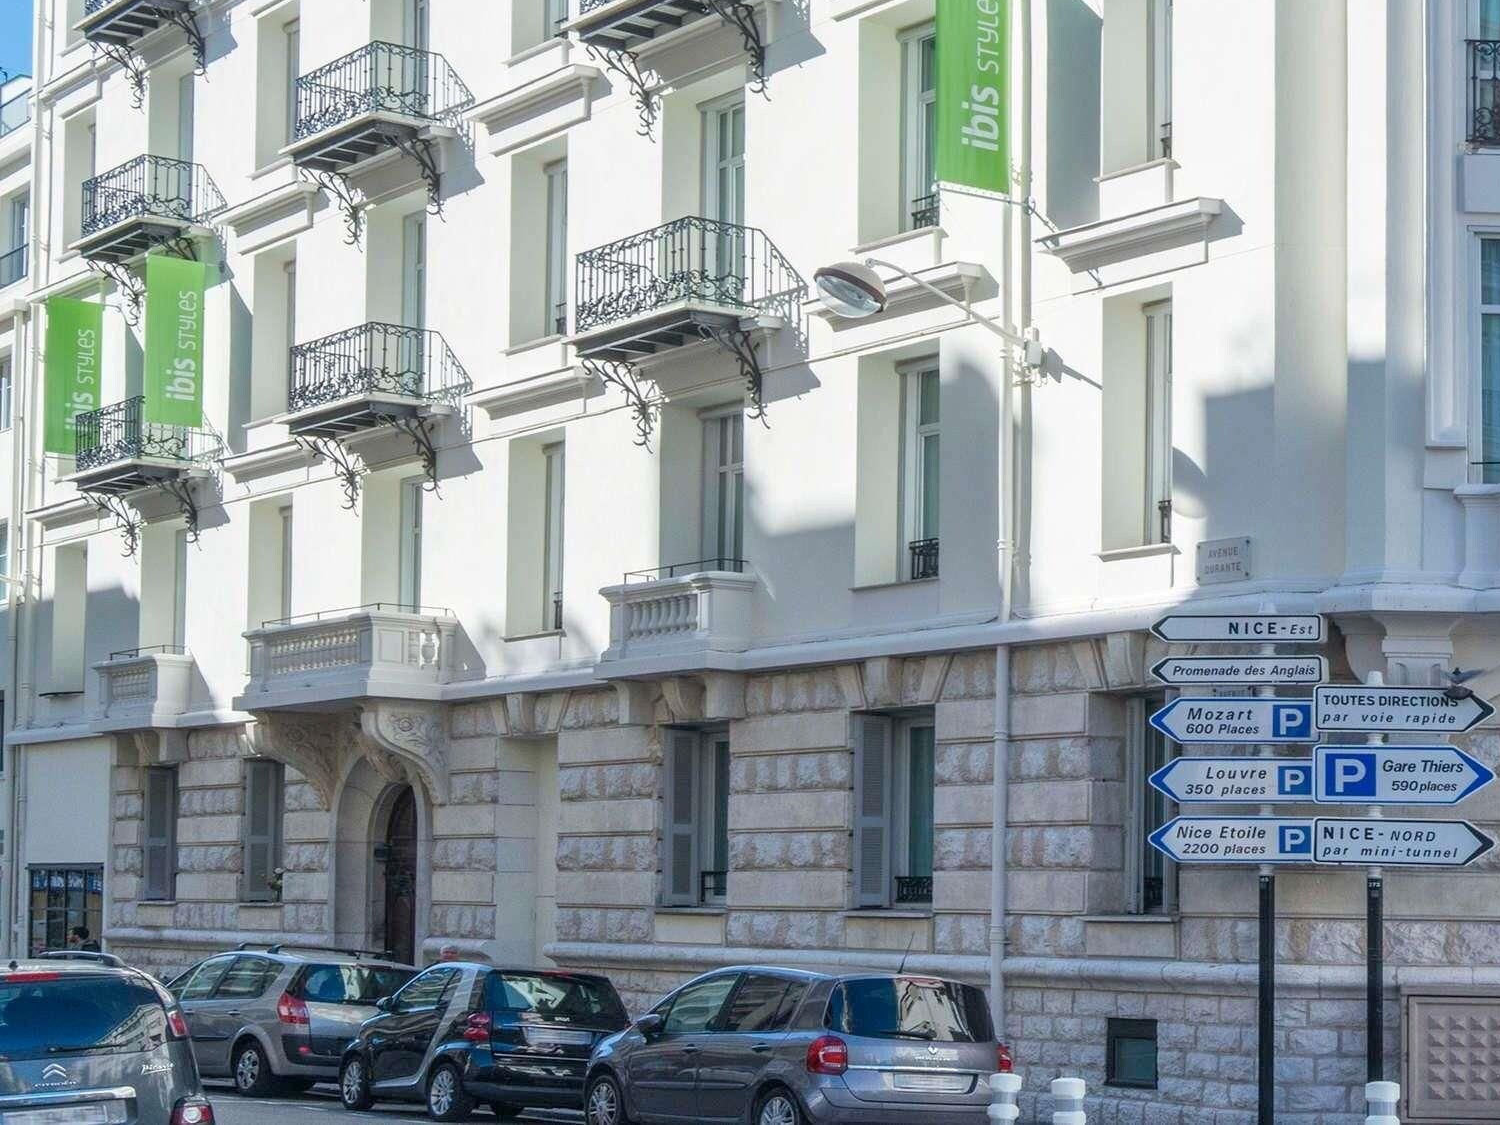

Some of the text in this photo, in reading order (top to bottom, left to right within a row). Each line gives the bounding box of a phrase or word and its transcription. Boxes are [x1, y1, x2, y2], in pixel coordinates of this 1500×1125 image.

[961, 84, 999, 152] ibis
[166, 358, 196, 402] ibis
[1207, 546, 1239, 559] AVENUE
[1172, 664, 1316, 678] Promenade des Anglais
[1323, 695, 1458, 707] TOUTES DIRECTIONS
[1187, 708, 1253, 721] Mozart
[1323, 712, 1456, 725] par voie rapide
[1279, 708, 1303, 735] P
[1186, 723, 1260, 735] 600 Places
[1205, 767, 1267, 779] Louvre
[1382, 760, 1464, 773] Gare Thiers
[1285, 769, 1305, 792] P
[1335, 758, 1366, 793] P
[1185, 784, 1266, 797] 350 places
[1391, 780, 1457, 793] 590 places
[1176, 826, 1266, 839] Nice Etoile
[1285, 829, 1305, 852] P
[1182, 843, 1266, 856] 2200 places
[1323, 846, 1458, 858] par mini-tunnel
